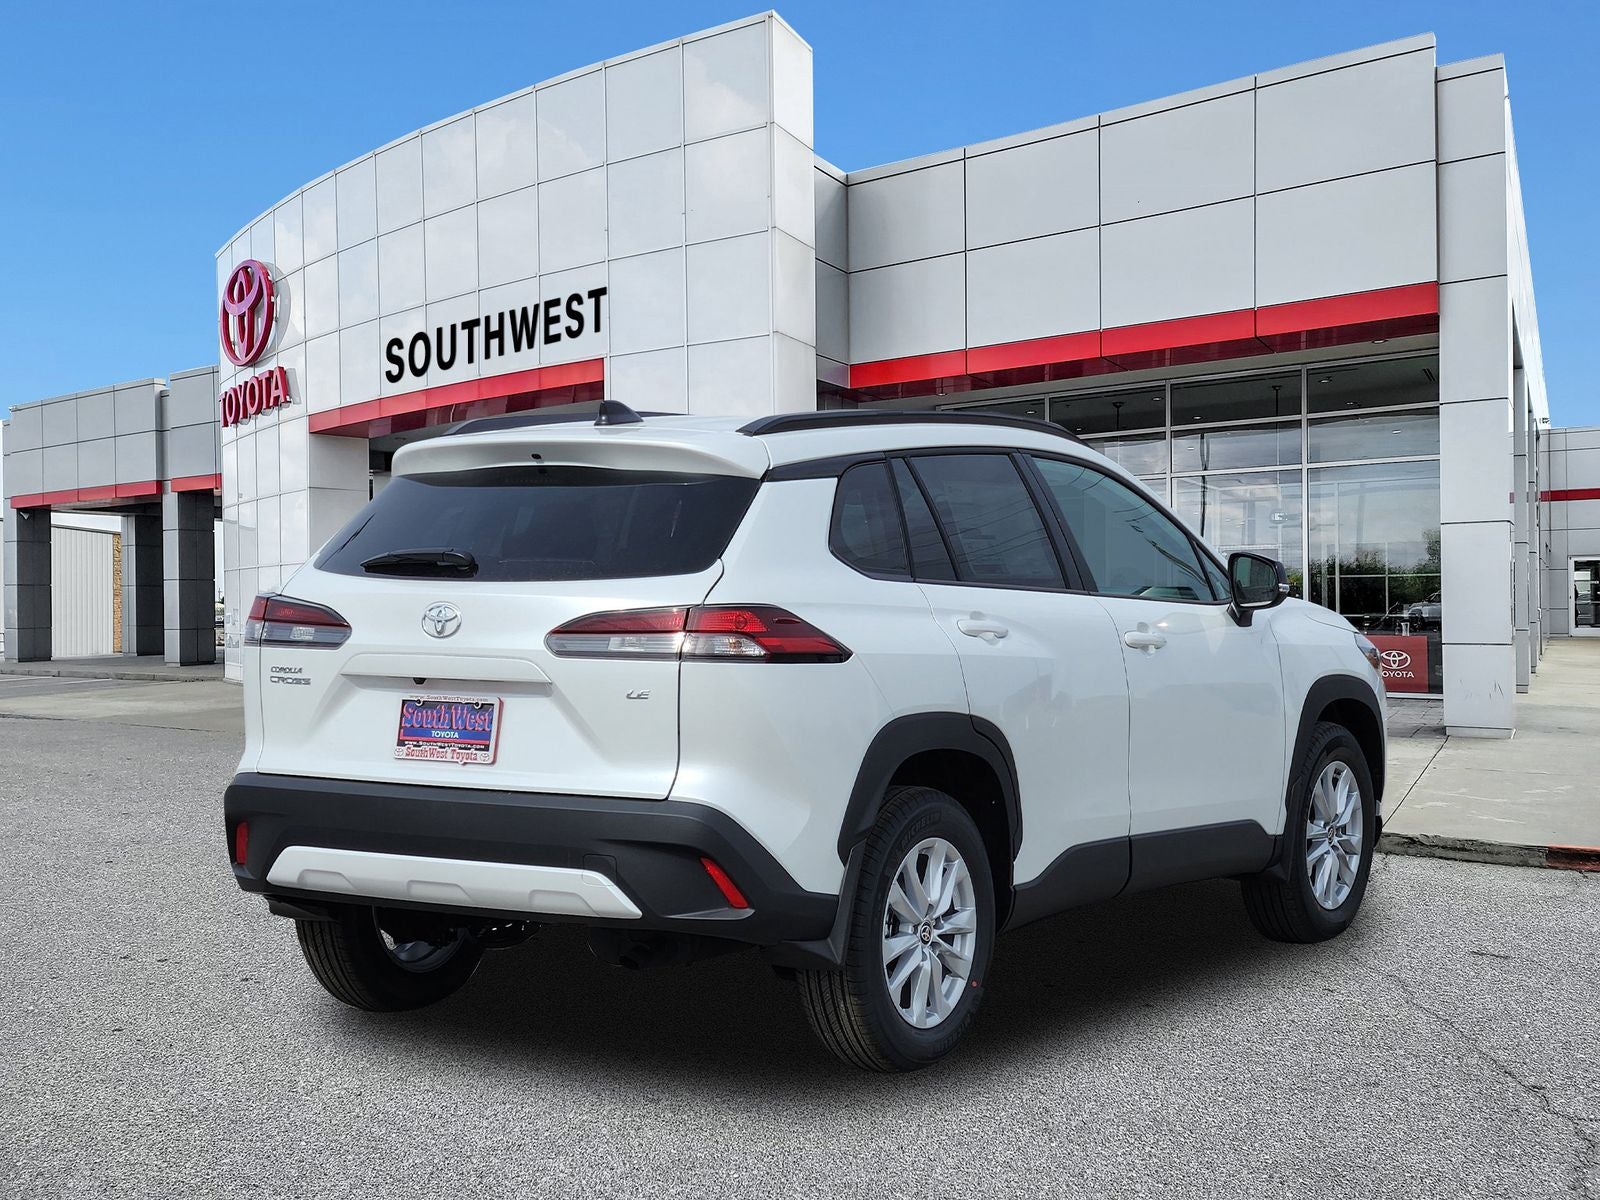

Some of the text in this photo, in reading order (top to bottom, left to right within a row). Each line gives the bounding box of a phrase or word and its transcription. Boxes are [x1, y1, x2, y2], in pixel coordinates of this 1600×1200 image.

[385, 287, 607, 383] SOUTHWEST
[218, 366, 290, 427] TOYOTA
[270, 666, 303, 674] COROLLA
[270, 676, 311, 685] CROSS
[626, 690, 651, 700] LE
[431, 730, 459, 739] TOYOTA
[450, 749, 478, 762] Toyota
